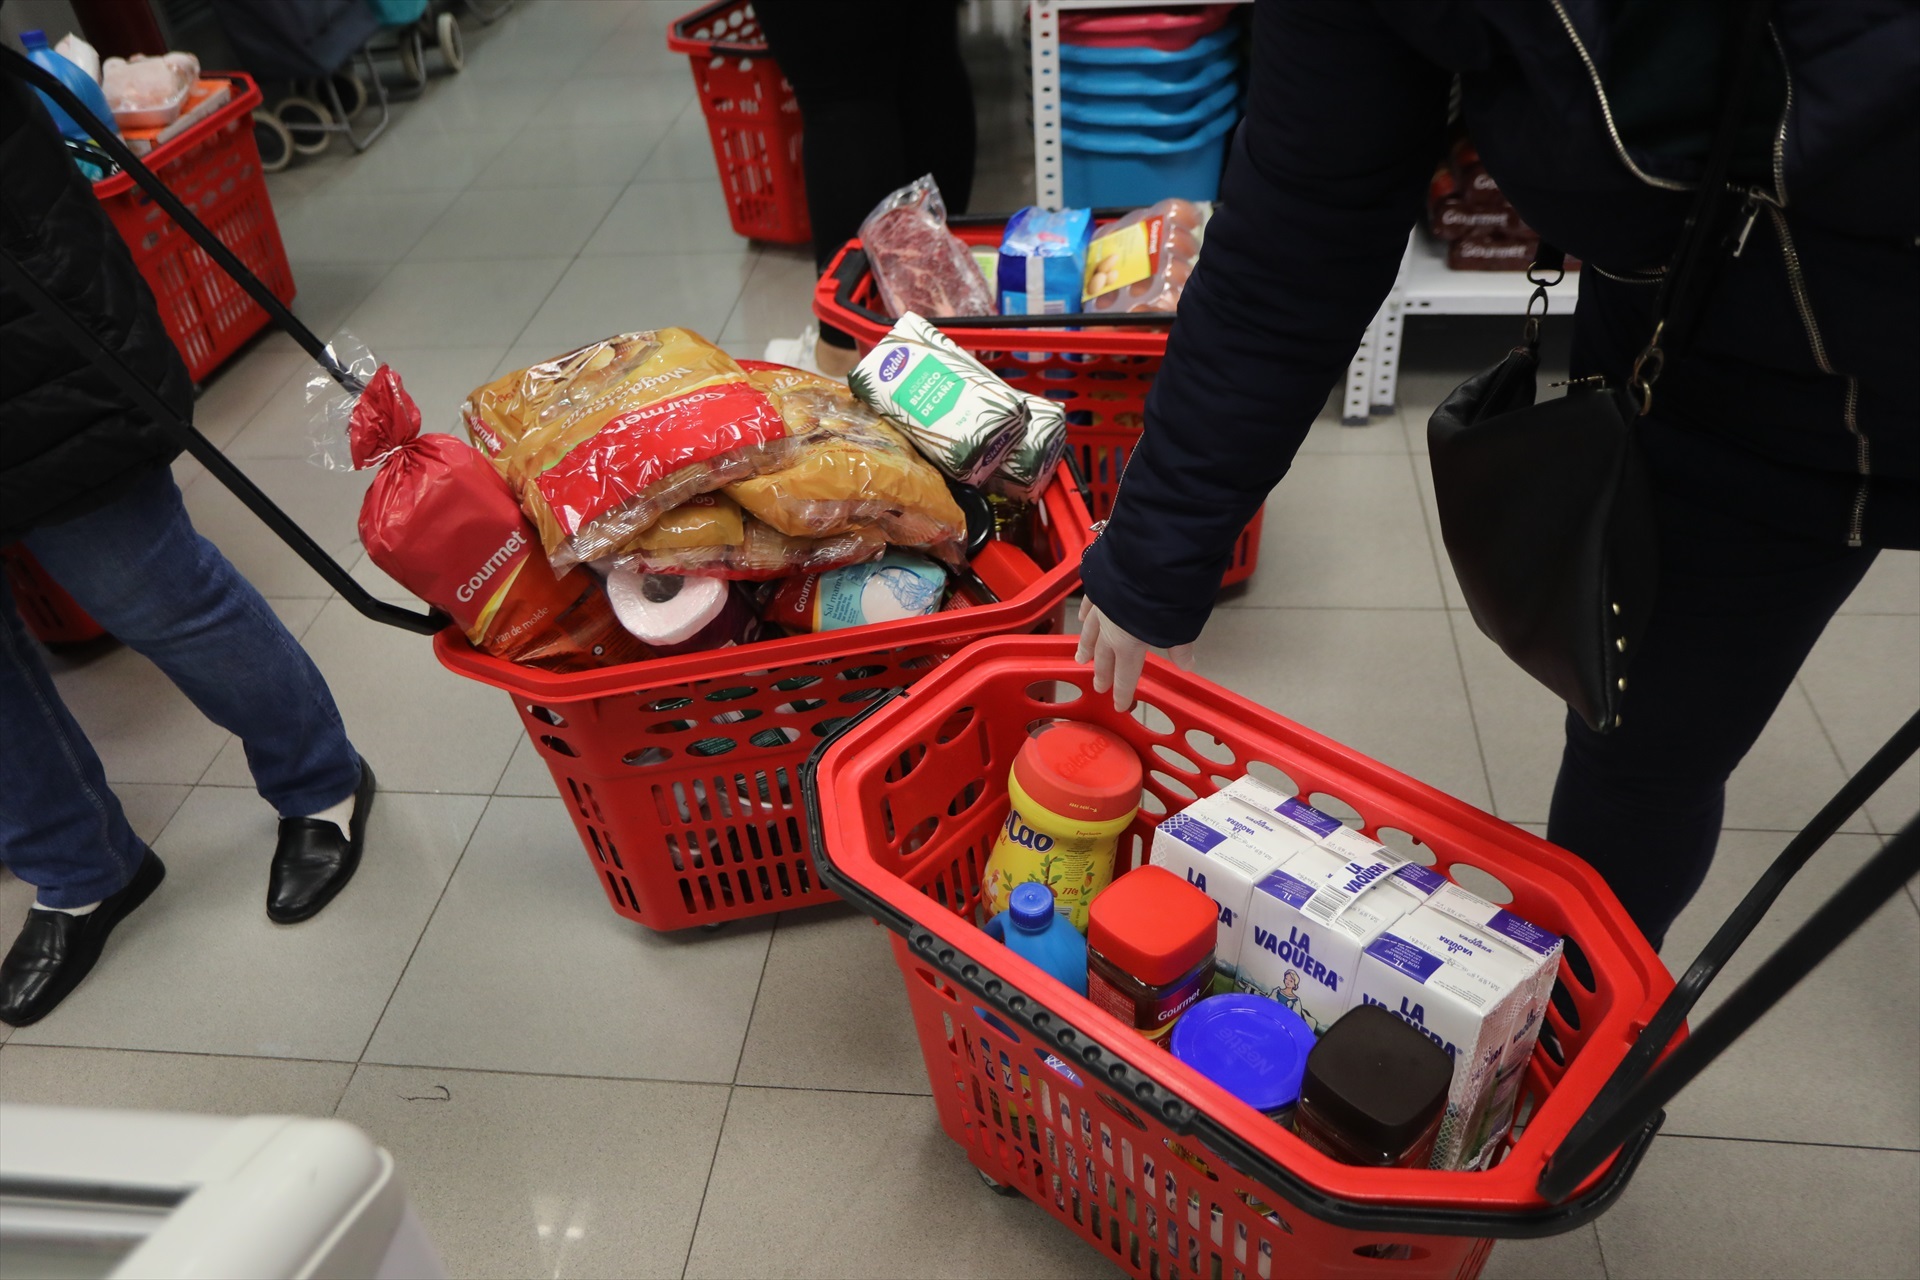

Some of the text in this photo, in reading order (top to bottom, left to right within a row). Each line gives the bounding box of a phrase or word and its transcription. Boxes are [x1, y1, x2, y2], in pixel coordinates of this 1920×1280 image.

[883, 348, 906, 380] Sidul
[909, 371, 942, 406] BLANCO
[920, 380, 956, 417] DE CAÑA
[613, 392, 726, 433] Gourmet
[456, 530, 528, 603] Gourmet
[794, 573, 817, 613] Gourme
[511, 625, 522, 637] de
[522, 607, 550, 630] molde
[823, 603, 834, 617] Sal
[1187, 867, 1206, 893] LA
[1343, 862, 1390, 894] VAQUERA
[1345, 862, 1365, 875] LA
[1289, 926, 1310, 954] LA
[1439, 935, 1473, 956] VAQUERA
[1254, 925, 1338, 992] VAQUERA
[1157, 988, 1201, 1021] Gourmet
[1400, 996, 1425, 1025] LA
